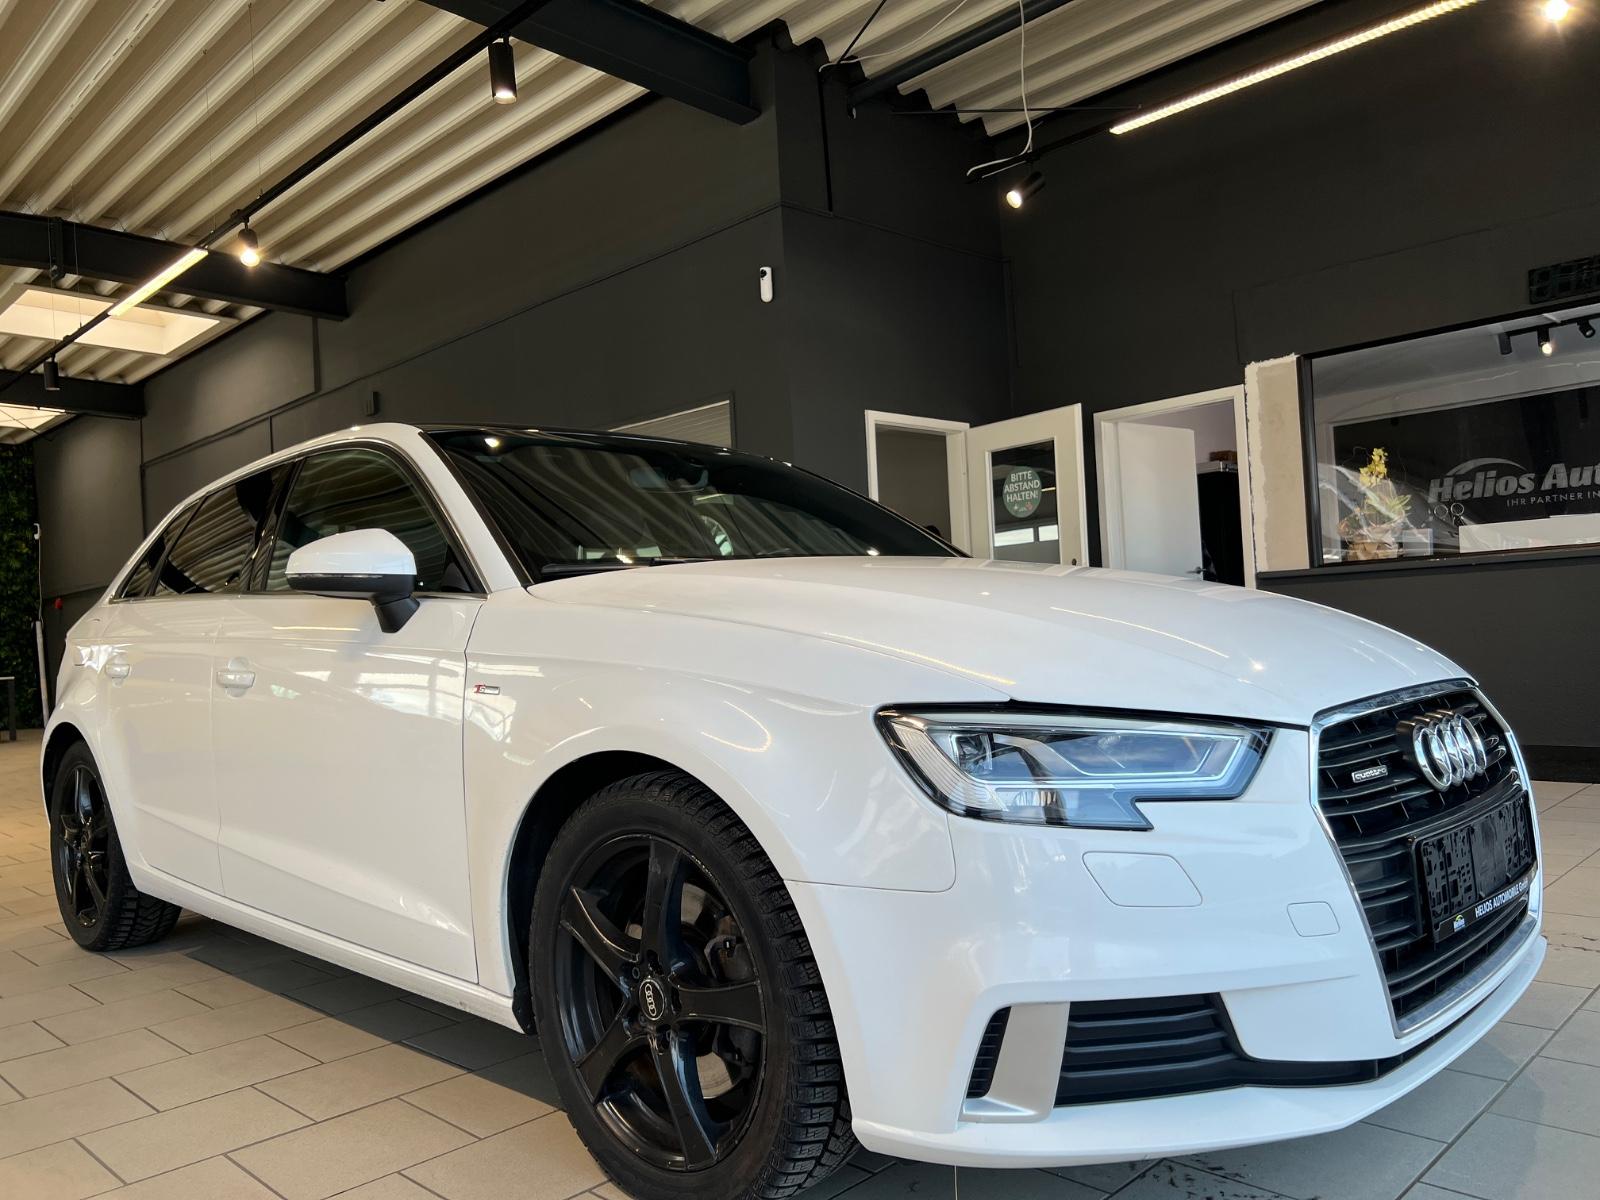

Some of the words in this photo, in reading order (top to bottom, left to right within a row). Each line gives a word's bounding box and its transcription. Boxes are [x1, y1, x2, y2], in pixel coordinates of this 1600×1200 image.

[1011, 470, 1032, 482] BITTE
[1004, 480, 1040, 494] ABSTAND
[1428, 471, 1535, 503] Helios
[1506, 498, 1526, 507] IHR
[1530, 492, 1583, 505] PARTNER
[1475, 899, 1493, 918] HELIOS
